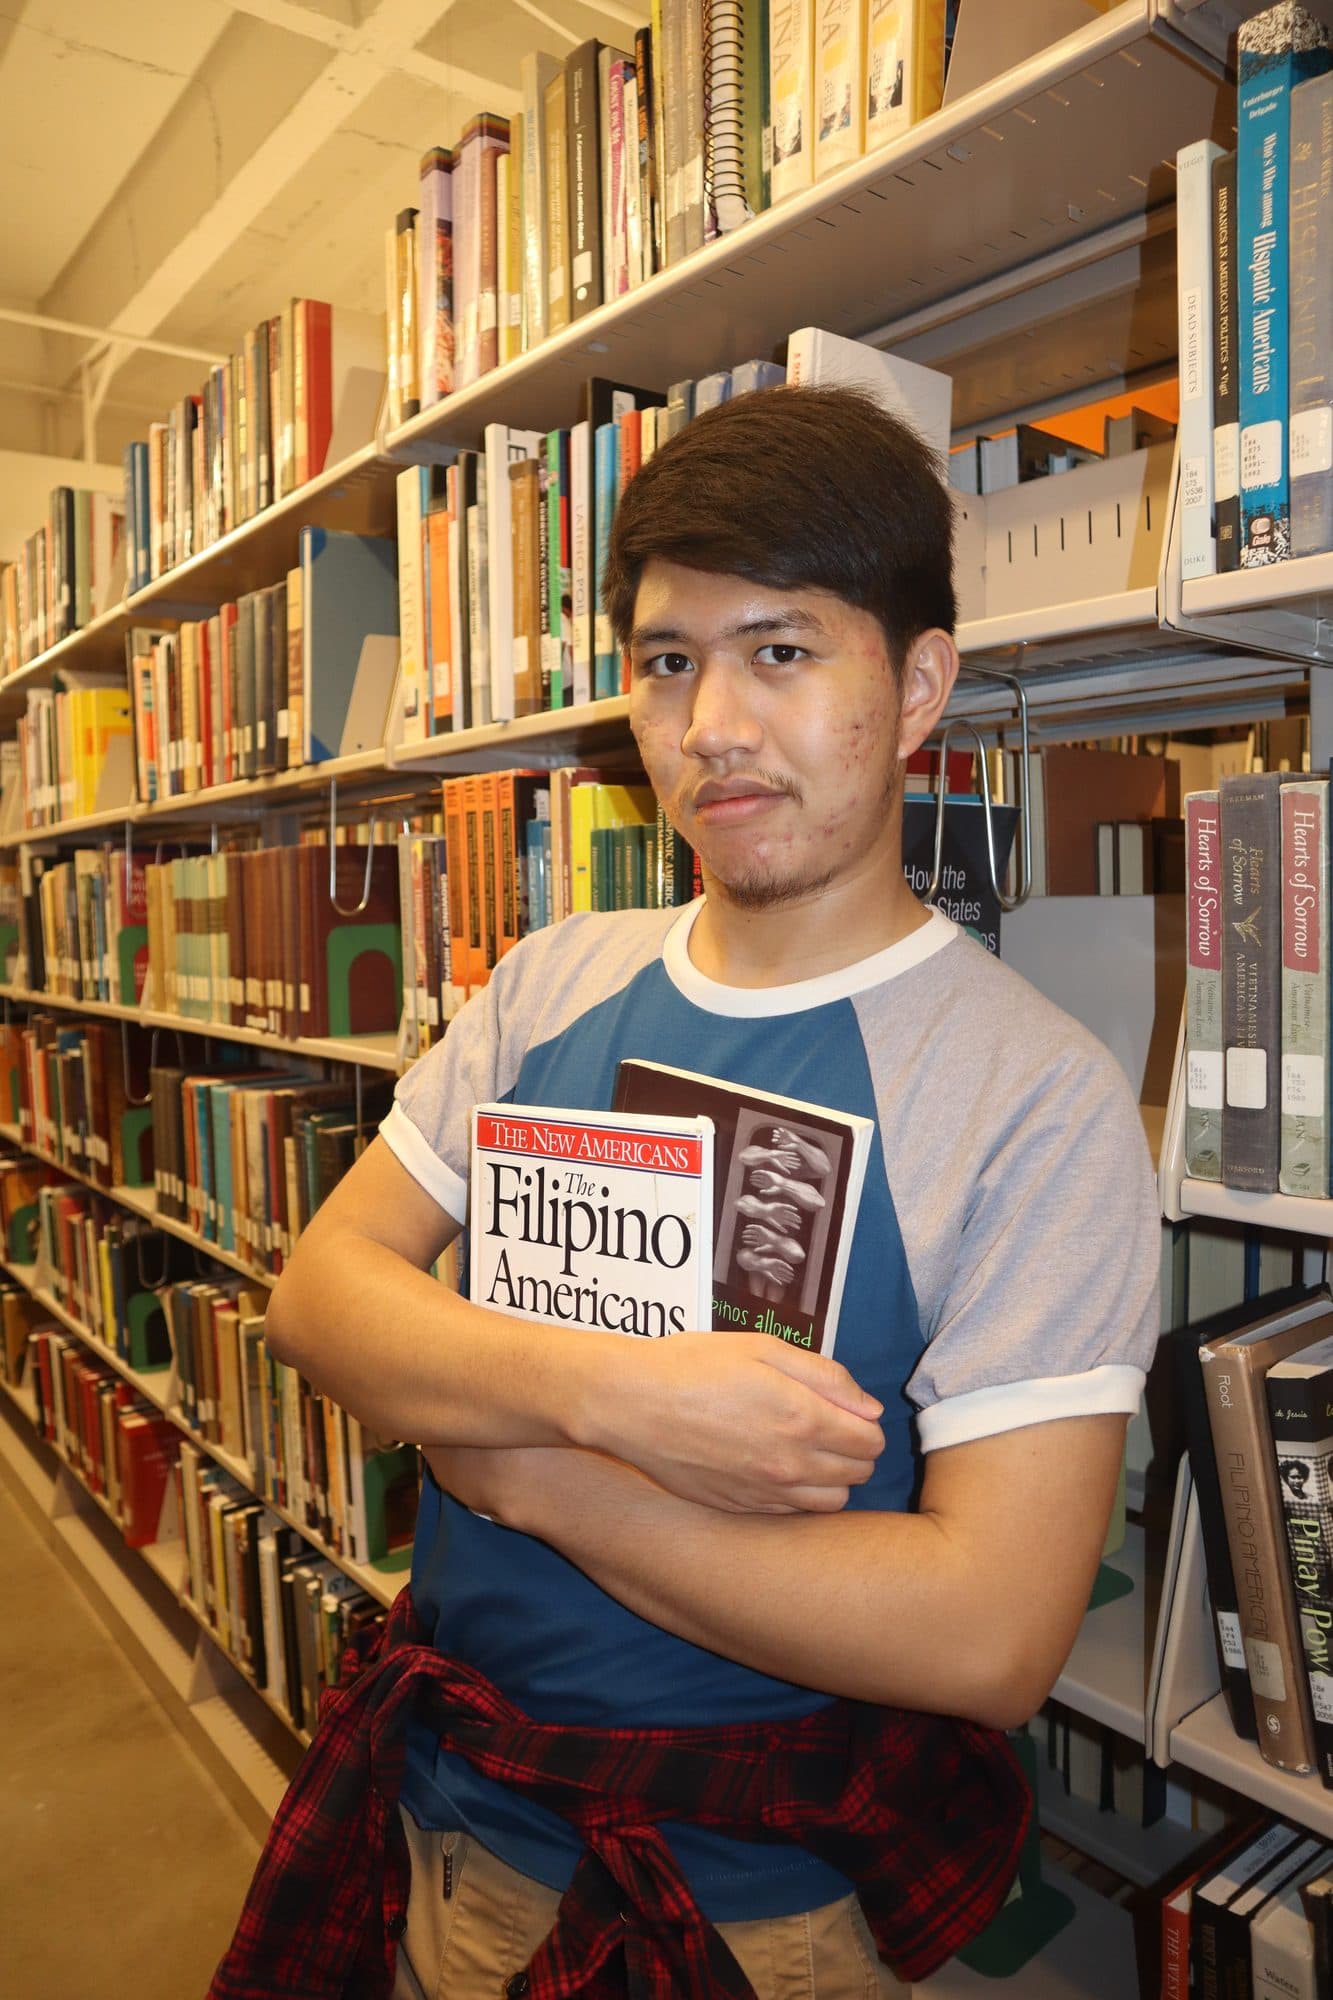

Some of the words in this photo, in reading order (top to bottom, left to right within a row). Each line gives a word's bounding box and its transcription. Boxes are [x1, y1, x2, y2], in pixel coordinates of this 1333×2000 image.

[1263, 132, 1277, 167] Who's
[1263, 166, 1277, 190] Who
[1218, 187, 1228, 243] HISPANICS
[1261, 191, 1273, 228] among
[1219, 245, 1228, 258] IN
[1249, 231, 1277, 305] Hispanic
[1219, 260, 1229, 314] AMERICAN
[1187, 296, 1200, 331] DEAD
[1188, 333, 1200, 394] SUBJECTS
[1220, 317, 1230, 363] POLITICS
[1252, 308, 1277, 396] Americans
[1198, 817, 1217, 872] Hearts
[1229, 838, 1247, 855] of
[1291, 810, 1316, 867] Hearts
[942, 864, 966, 890] the
[1194, 875, 1218, 894] of
[1231, 856, 1247, 906] Sorrow
[1249, 847, 1264, 896] Hearts
[1289, 873, 1316, 892] of
[440, 874, 450, 928] GROWING
[937, 896, 981, 921] States
[442, 930, 450, 946] UP
[1197, 895, 1217, 957] Sorrow
[1291, 894, 1315, 958] Sorrow
[490, 1121, 529, 1151] THE
[531, 1126, 577, 1157] NEW
[577, 1132, 690, 1172] AMERICANS
[564, 1171, 597, 1197] The
[484, 1161, 693, 1278] Filipino
[484, 1247, 696, 1342] Americans
[754, 1308, 813, 1349] allowed
[1217, 1375, 1235, 1409] Root
[1227, 1453, 1256, 1540] FILIPINO
[1289, 1517, 1322, 1600] Pinay
[1166, 1928, 1181, 1960] THE
